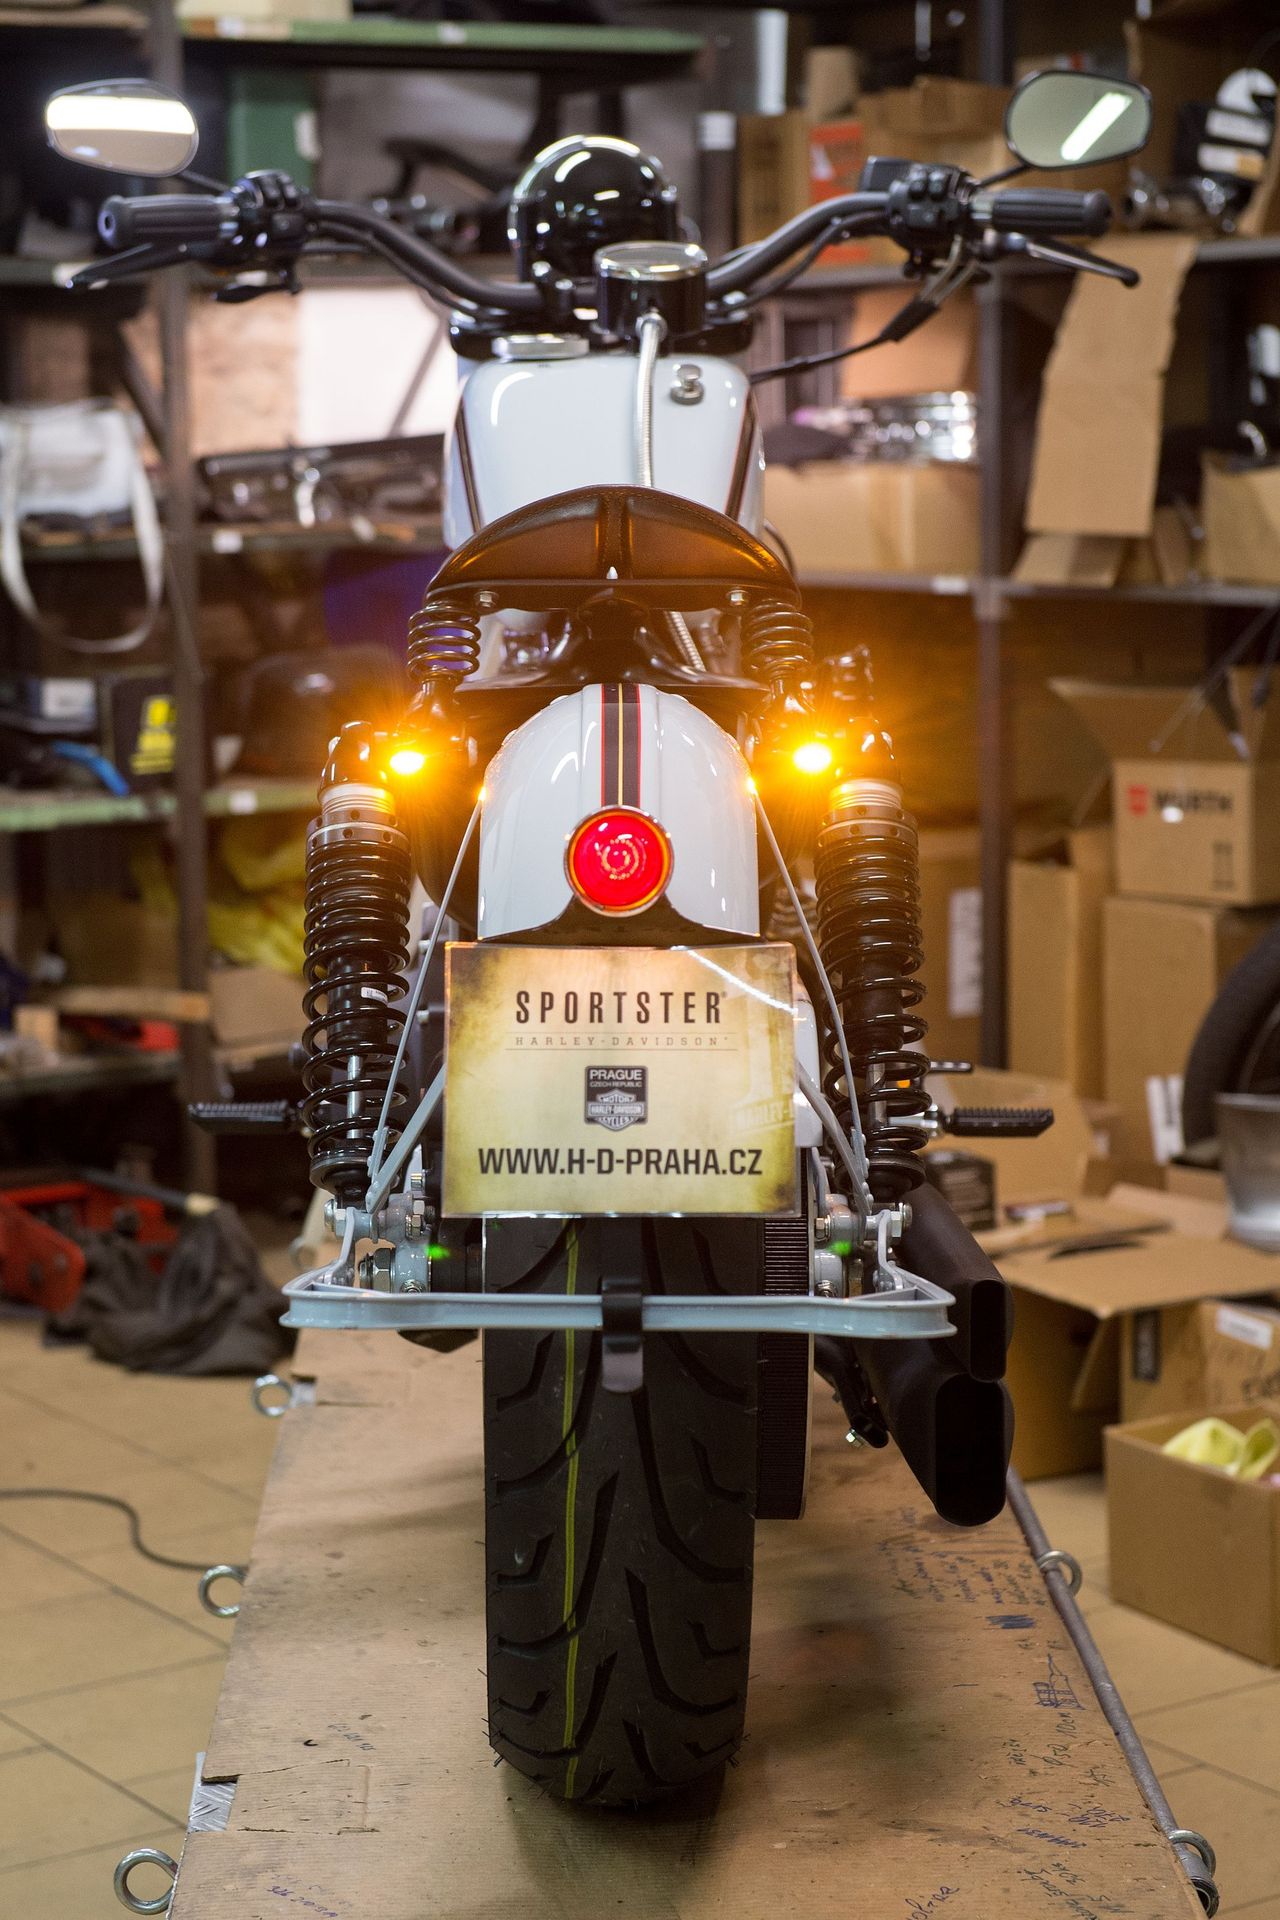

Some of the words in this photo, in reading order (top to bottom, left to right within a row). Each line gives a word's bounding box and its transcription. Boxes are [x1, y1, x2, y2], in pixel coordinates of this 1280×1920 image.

[515, 990, 721, 1024] SPORTSTER
[589, 1069, 643, 1081] PRAGUE
[478, 1148, 763, 1175] WWW.H-D-PRAHA.CZ
